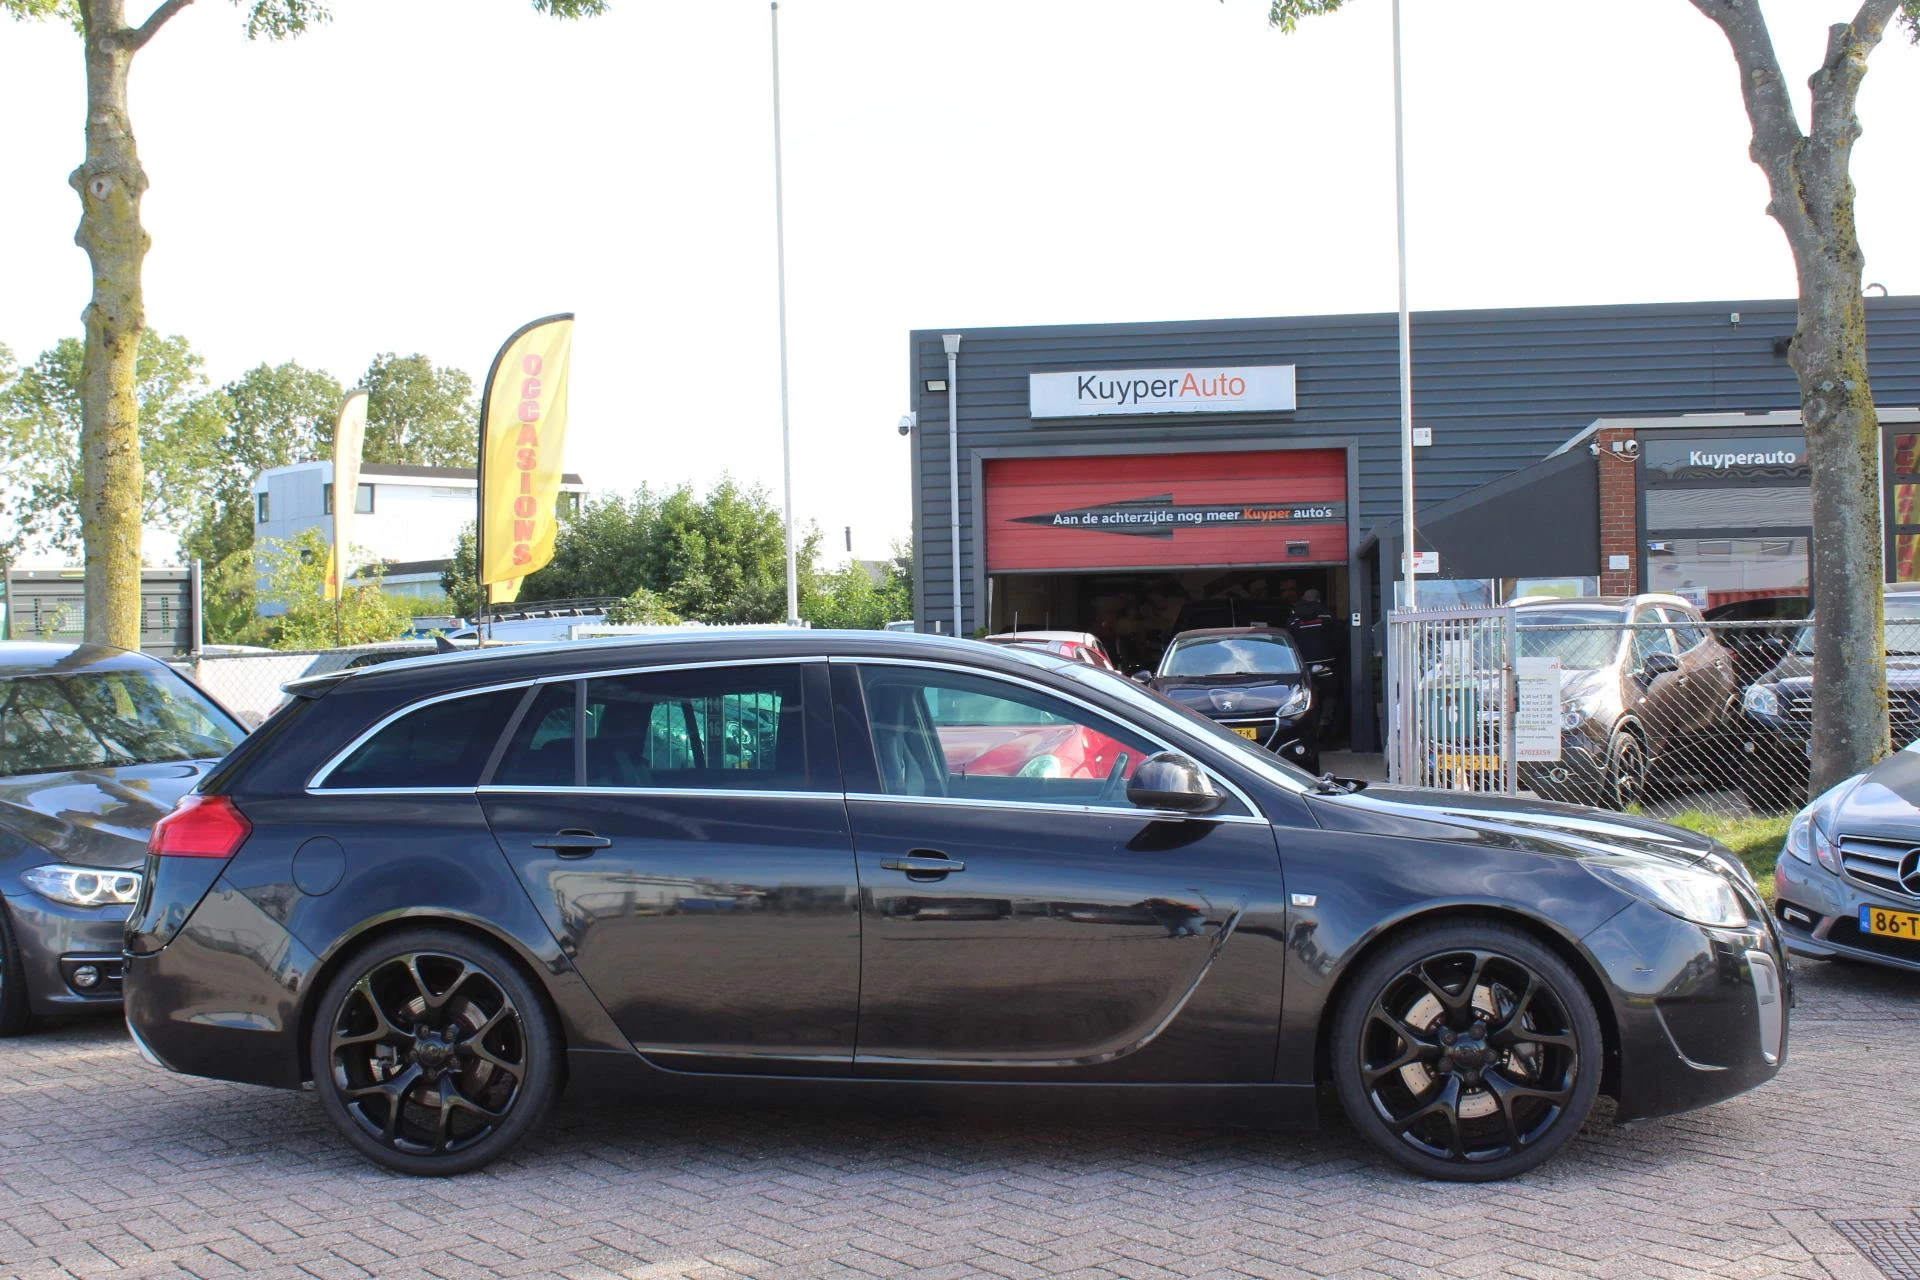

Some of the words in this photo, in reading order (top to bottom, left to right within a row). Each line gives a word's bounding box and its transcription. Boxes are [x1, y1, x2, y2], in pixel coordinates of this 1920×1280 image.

[1077, 372, 1246, 405] KuyperAuto
[512, 353, 544, 566] OCCASIONS
[1053, 514, 1079, 525] Aan
[1082, 513, 1098, 524] de
[1102, 511, 1174, 525] achterzijde
[1177, 512, 1203, 524] nog
[1206, 510, 1241, 521] meer
[1243, 508, 1291, 522] Kuyper
[1293, 506, 1333, 519] auto's
[708, 720, 720, 737] 16
[1875, 912, 1919, 936] 86-T
